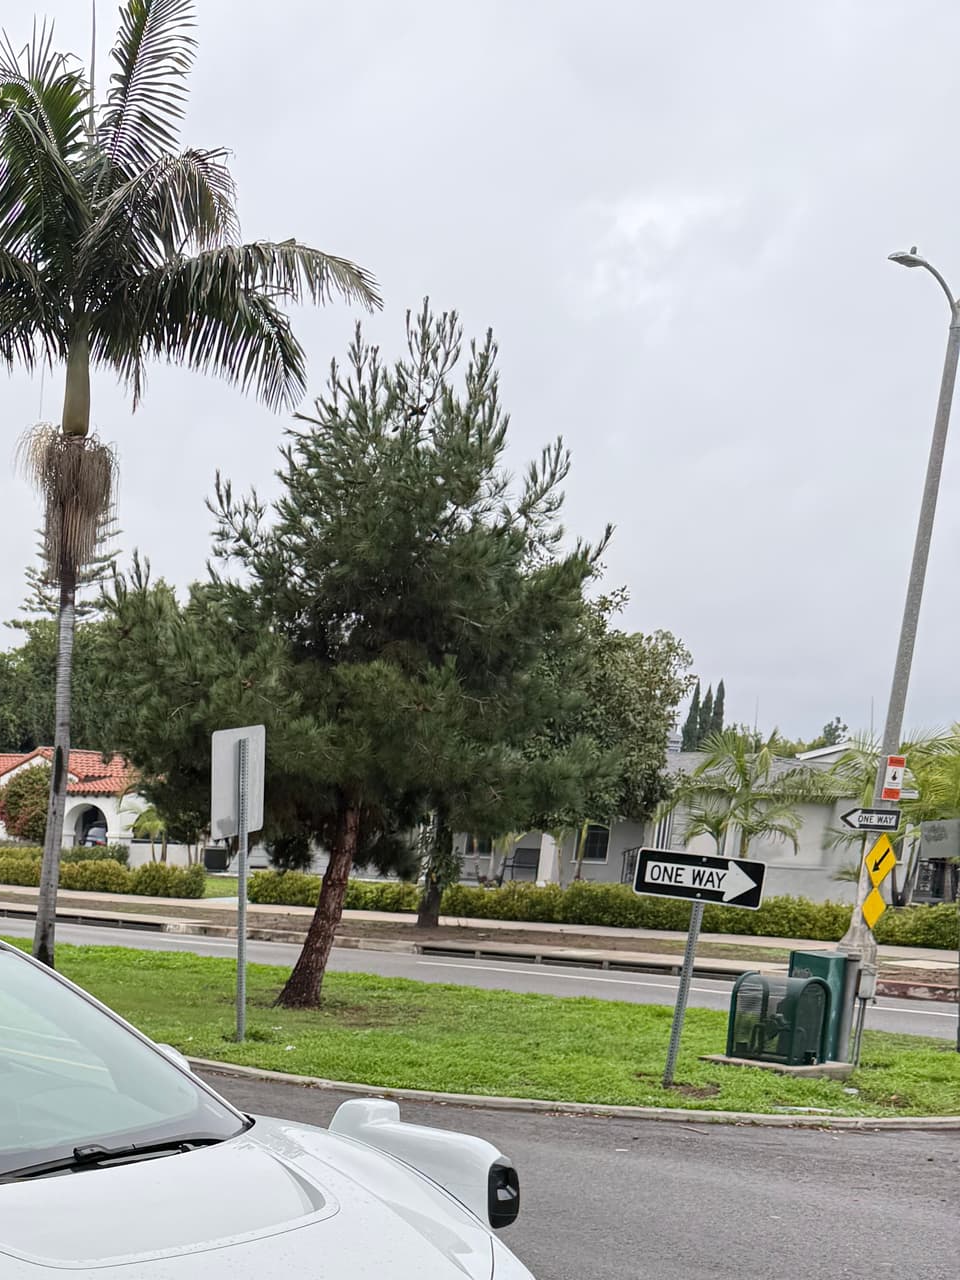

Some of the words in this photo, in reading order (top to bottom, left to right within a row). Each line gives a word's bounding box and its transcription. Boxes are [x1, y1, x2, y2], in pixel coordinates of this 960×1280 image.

[857, 815, 875, 824] ONE
[877, 815, 894, 824] WAY
[650, 864, 685, 884] ONE
[692, 868, 727, 889] WAY
